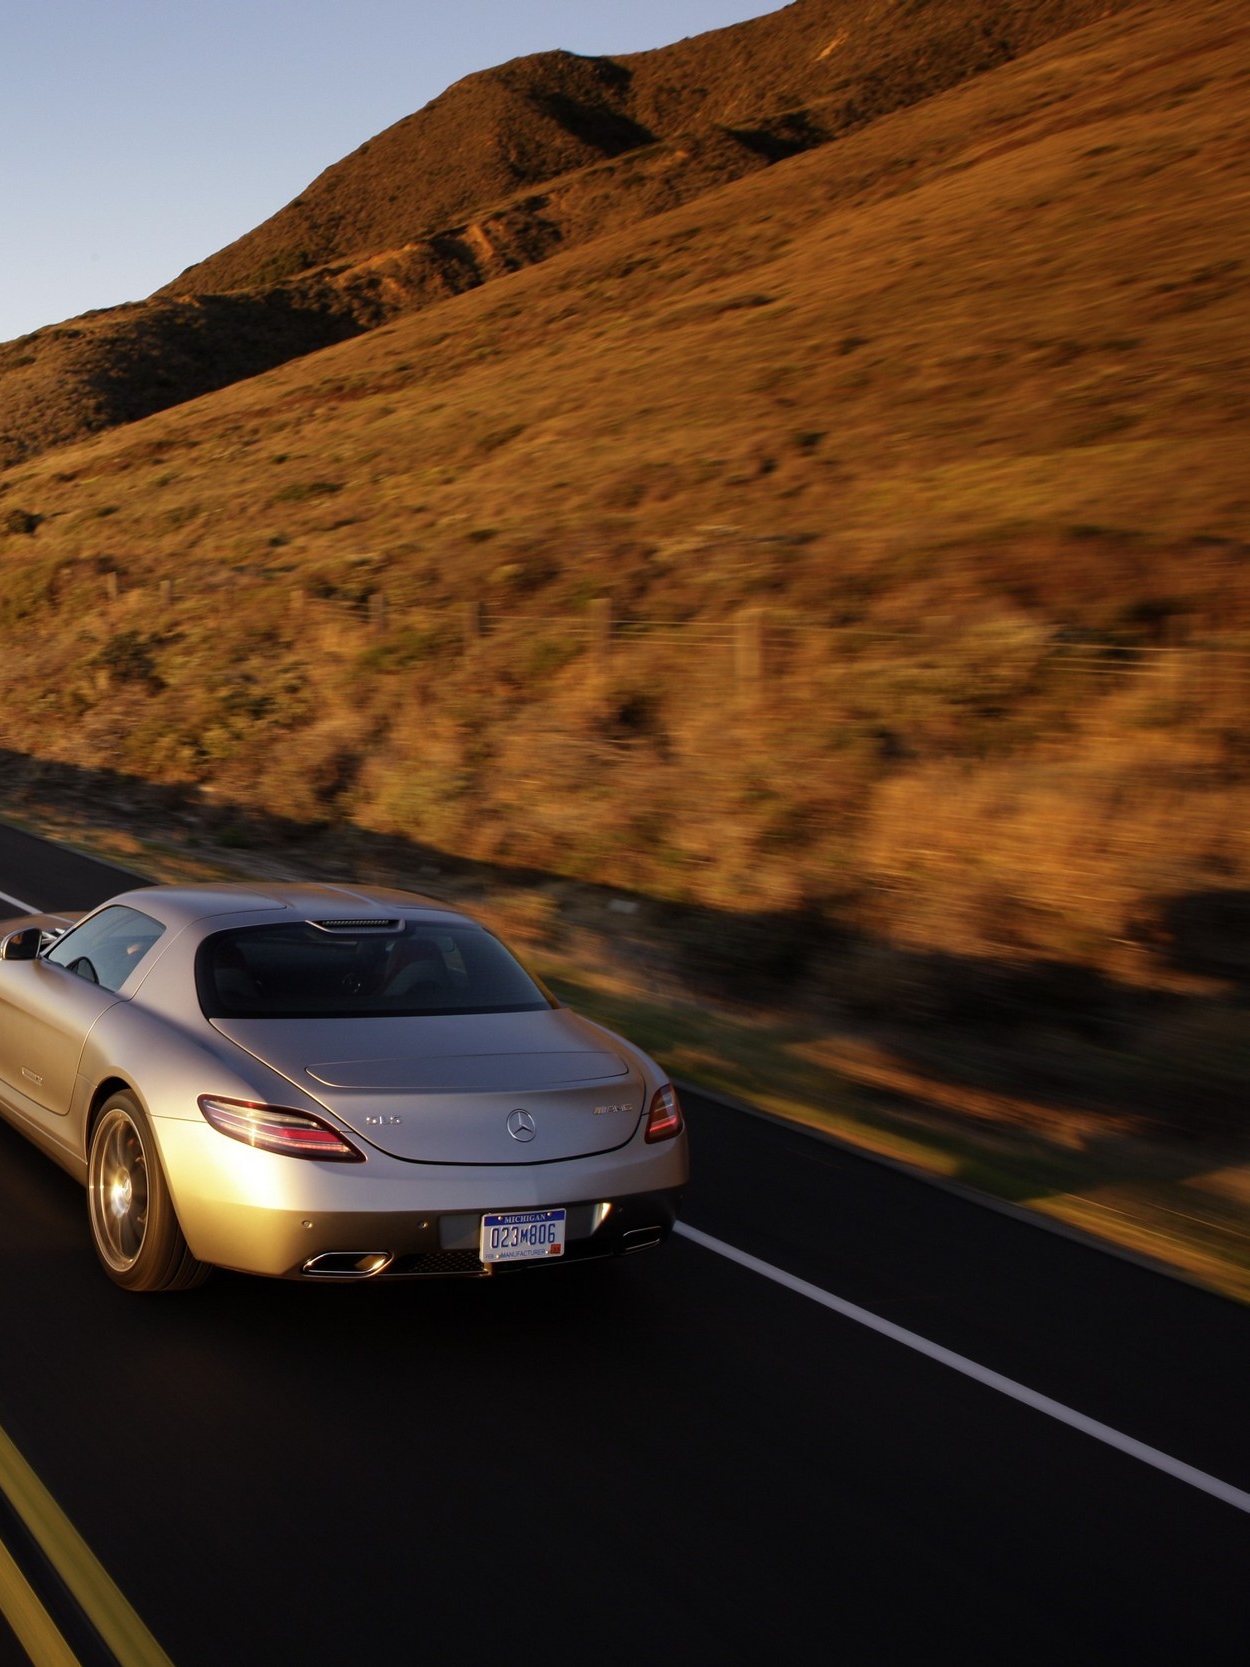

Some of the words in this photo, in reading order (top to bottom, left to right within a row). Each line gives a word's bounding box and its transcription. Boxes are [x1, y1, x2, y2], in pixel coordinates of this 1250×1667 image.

[504, 1213, 547, 1224] MICHIGAN
[490, 1223, 556, 1249] 023M806
[500, 1248, 546, 1259] MANUFACTURER
